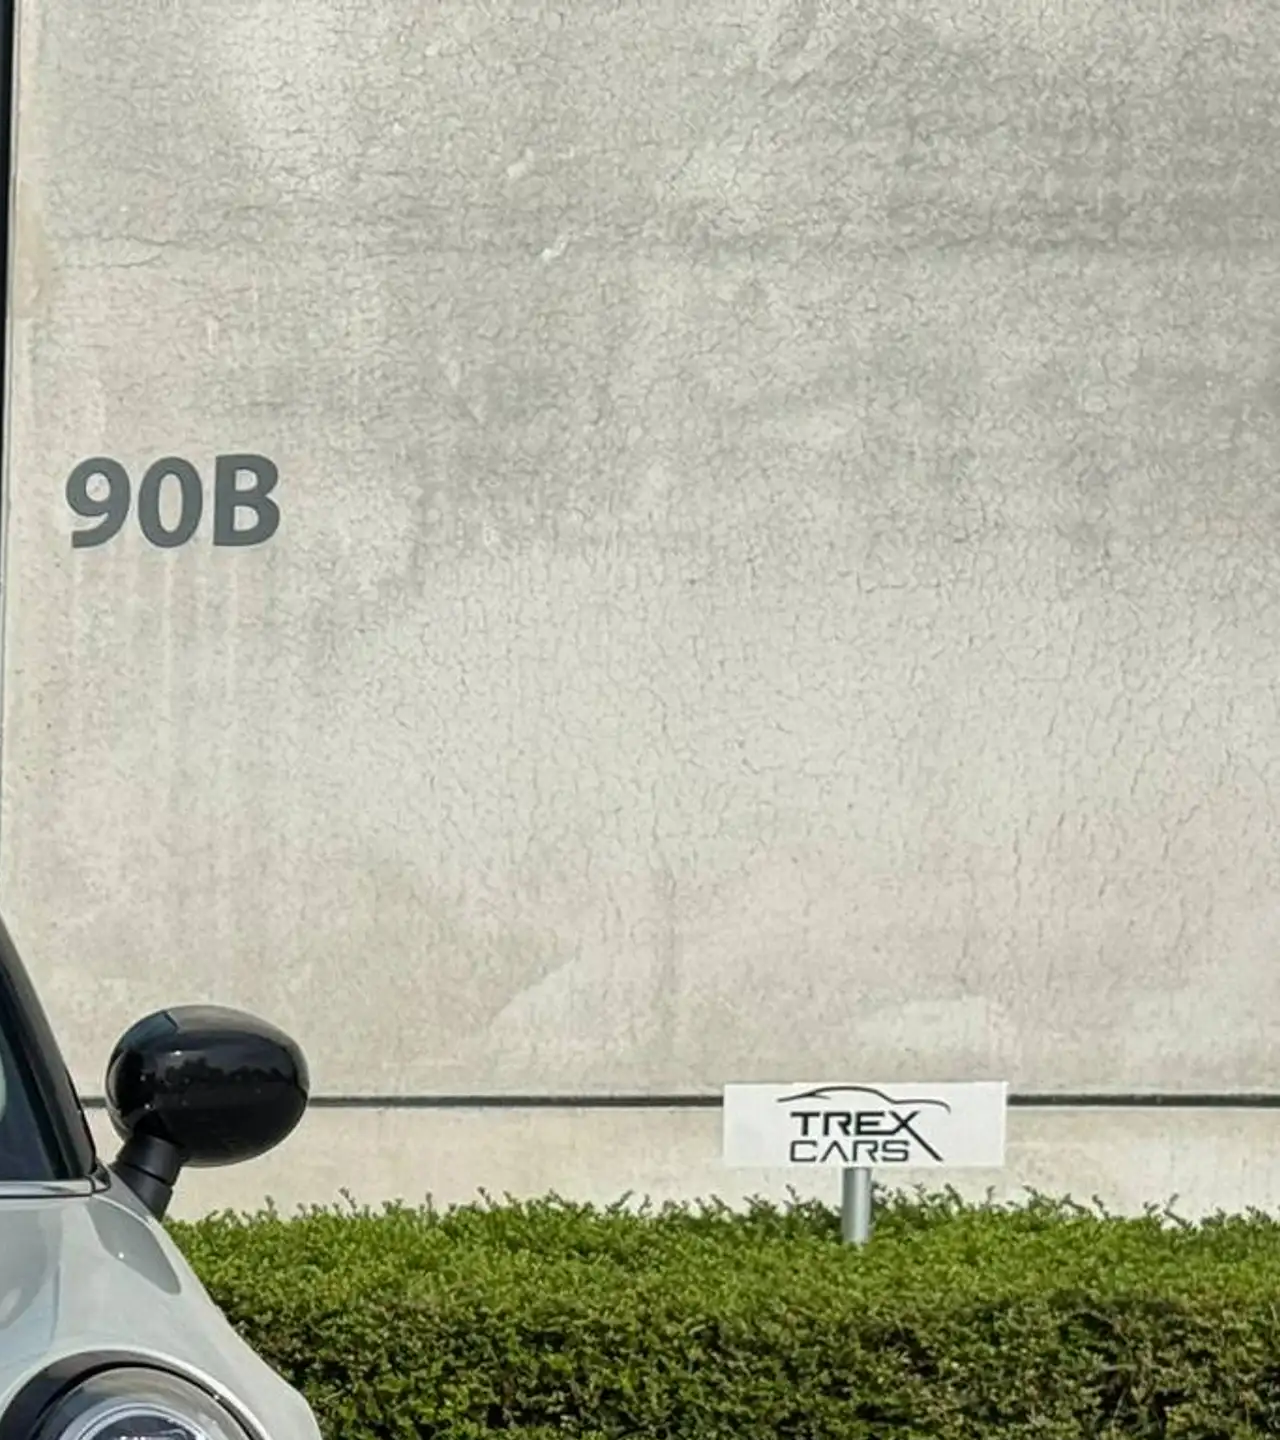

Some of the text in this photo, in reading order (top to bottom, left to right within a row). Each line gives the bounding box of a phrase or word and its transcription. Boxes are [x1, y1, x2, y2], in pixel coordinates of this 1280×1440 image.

[66, 453, 281, 549] 90B
[790, 1110, 943, 1162] TREX
[790, 1140, 910, 1162] CARS
